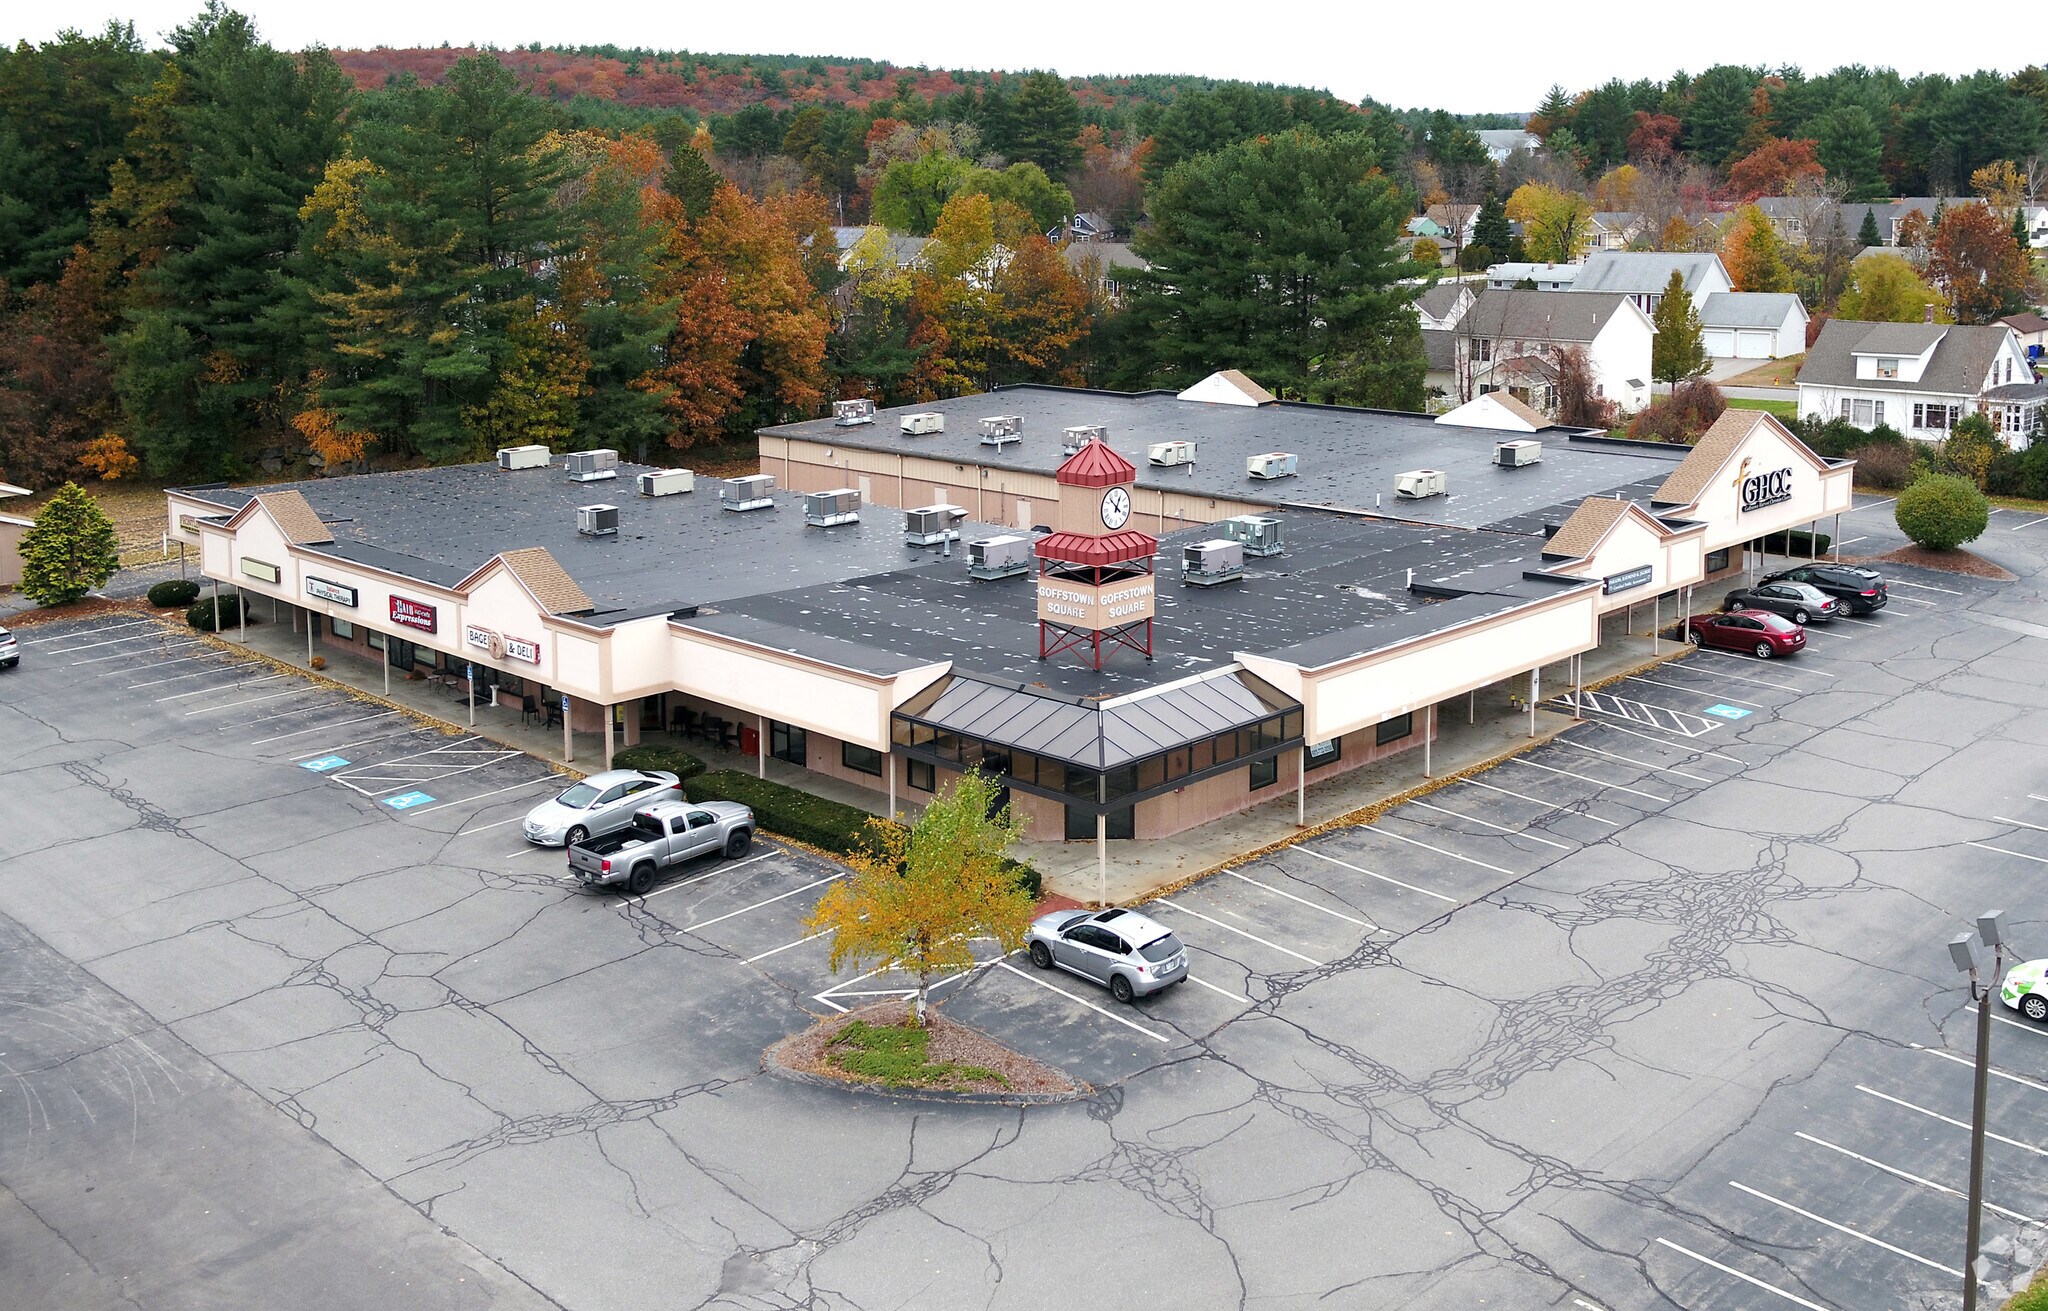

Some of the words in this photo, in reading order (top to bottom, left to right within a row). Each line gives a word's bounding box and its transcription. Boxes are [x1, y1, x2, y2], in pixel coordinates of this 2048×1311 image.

[1742, 467, 1792, 504] GHCC
[1039, 586, 1095, 606] GOFFSTOWN
[1100, 584, 1154, 606] GOFFSTOWN
[396, 599, 413, 615] HAIR
[1047, 602, 1085, 618] SQUARE
[1109, 600, 1145, 618] SQUARE
[392, 611, 432, 626] Expressions
[469, 630, 488, 645] BAGE
[509, 641, 515, 654] &
[516, 644, 533, 659] DELI
